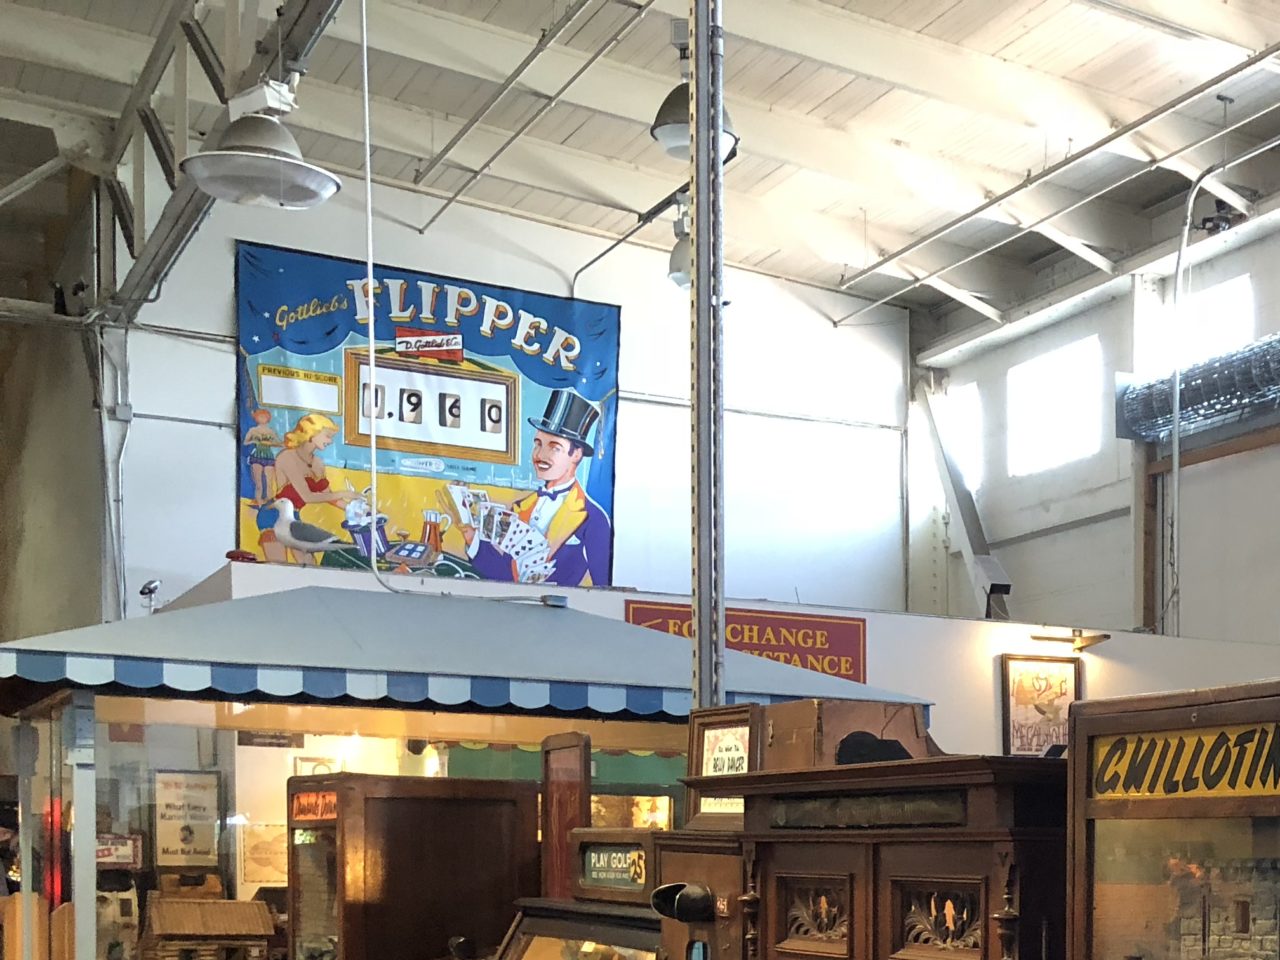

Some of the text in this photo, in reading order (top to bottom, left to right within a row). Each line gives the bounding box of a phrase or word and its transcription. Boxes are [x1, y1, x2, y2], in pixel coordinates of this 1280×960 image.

[275, 294, 348, 330] Gottlieb's
[346, 278, 581, 370] FLIPPER
[262, 366, 300, 378] PREVIOUS
[725, 623, 830, 649] CHANGE
[591, 852, 630, 868] PLAY GOLF
